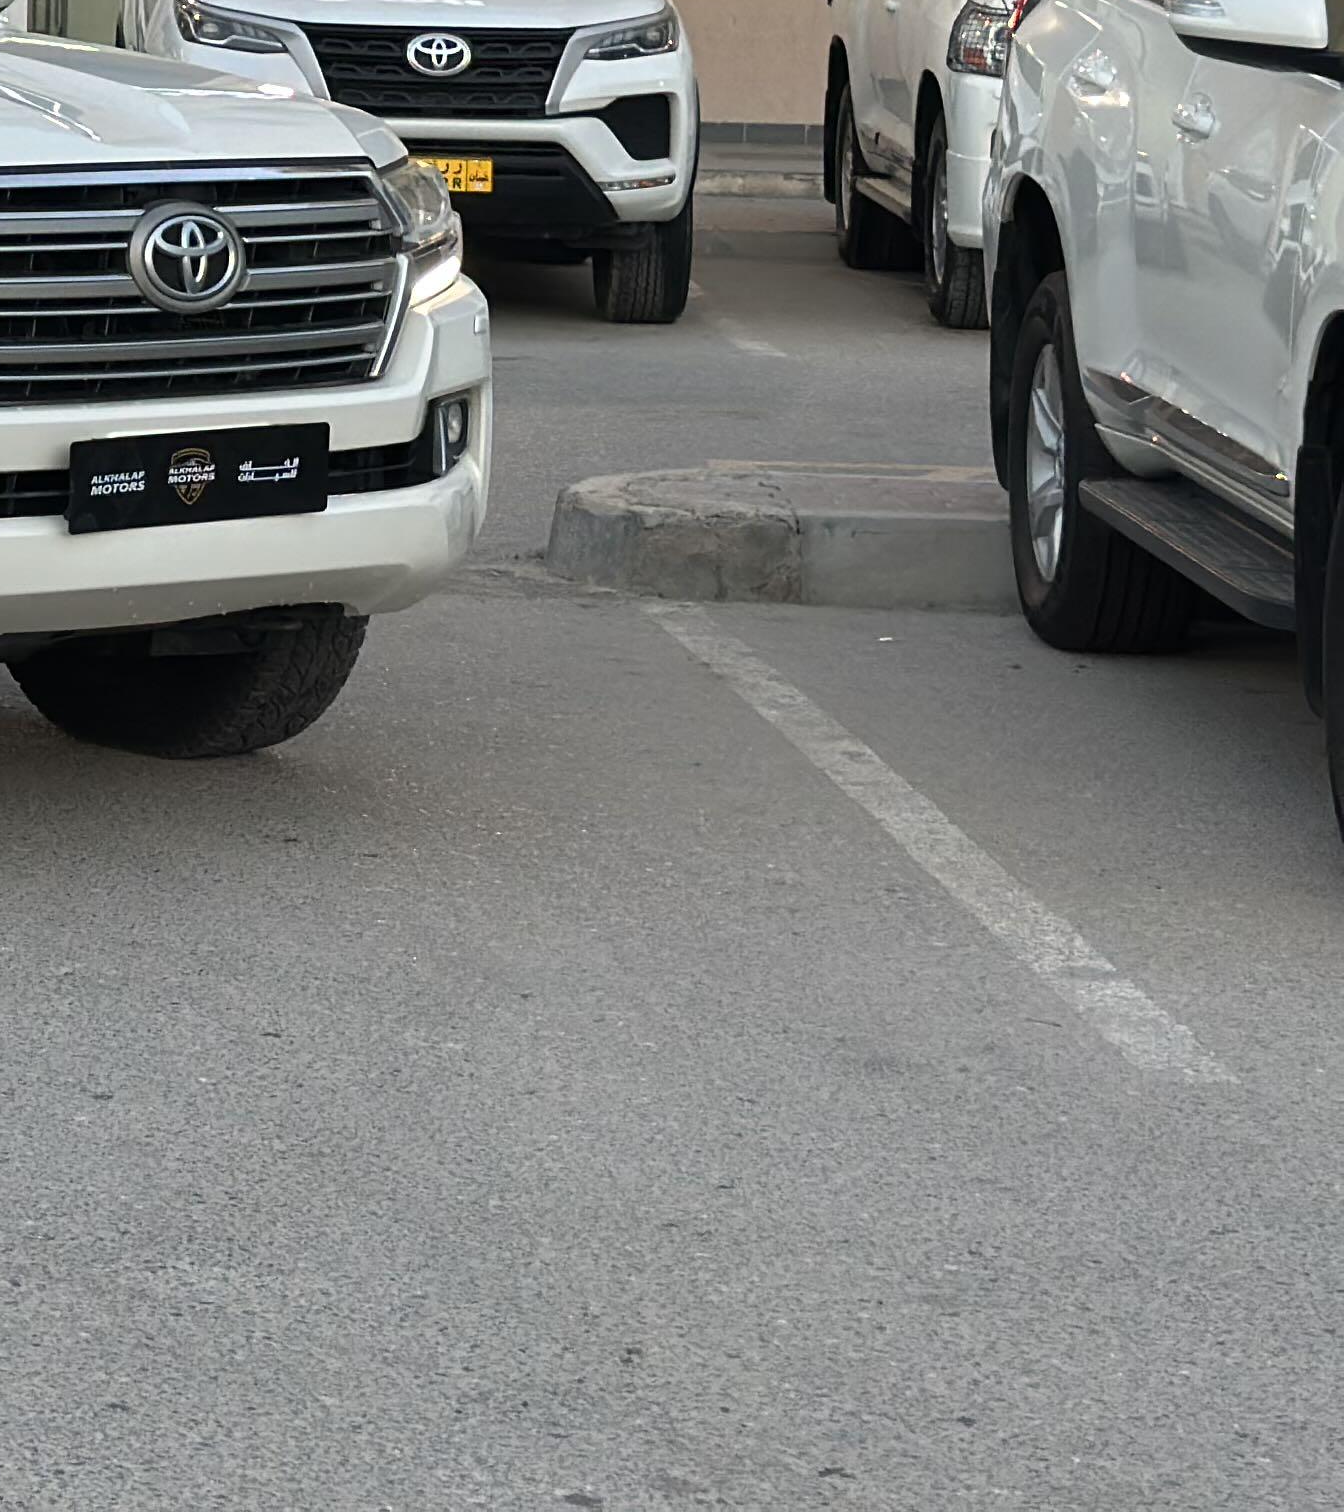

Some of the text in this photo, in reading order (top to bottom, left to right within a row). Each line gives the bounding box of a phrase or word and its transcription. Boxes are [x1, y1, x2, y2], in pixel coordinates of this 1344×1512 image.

[168, 464, 216, 475] ALKHALAF
[91, 470, 146, 485] ALKHALAF
[167, 472, 216, 485] MOTORS
[90, 481, 146, 496] MOTORS
